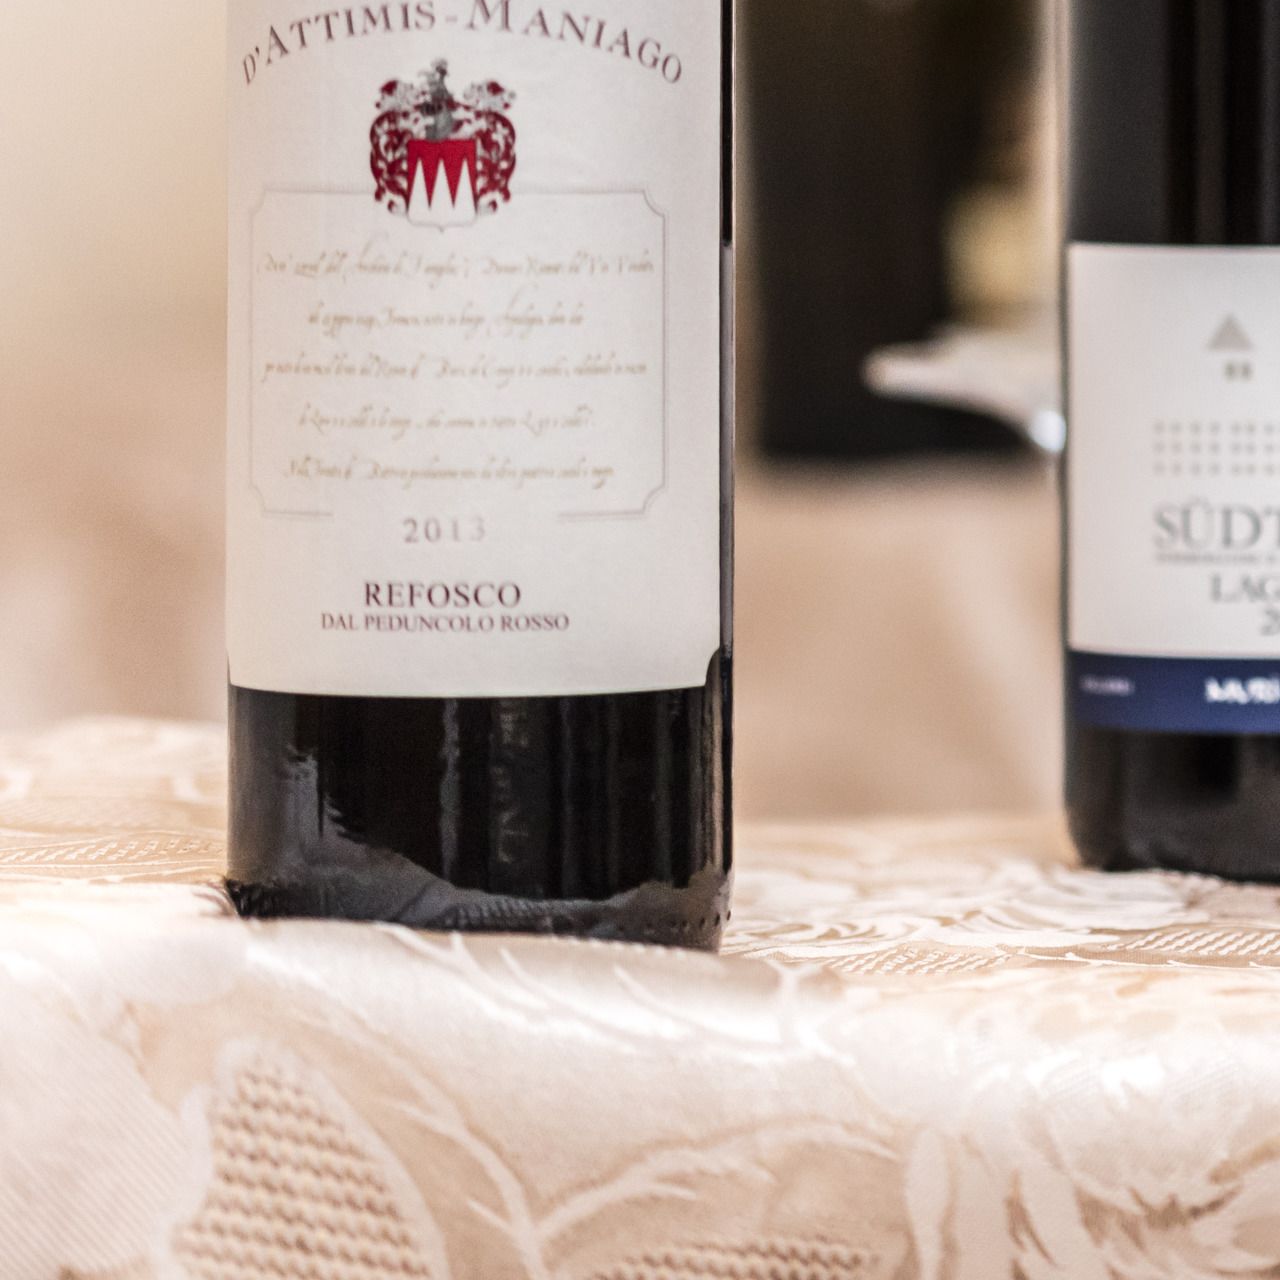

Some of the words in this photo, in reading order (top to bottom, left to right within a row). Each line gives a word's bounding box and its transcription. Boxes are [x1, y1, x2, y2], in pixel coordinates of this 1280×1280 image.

[402, 517, 488, 545] 2013
[364, 581, 522, 609] REFOSCO
[320, 612, 359, 632] DAL
[364, 612, 495, 633] PEDUNCOLO
[500, 612, 571, 632] ROSSO
